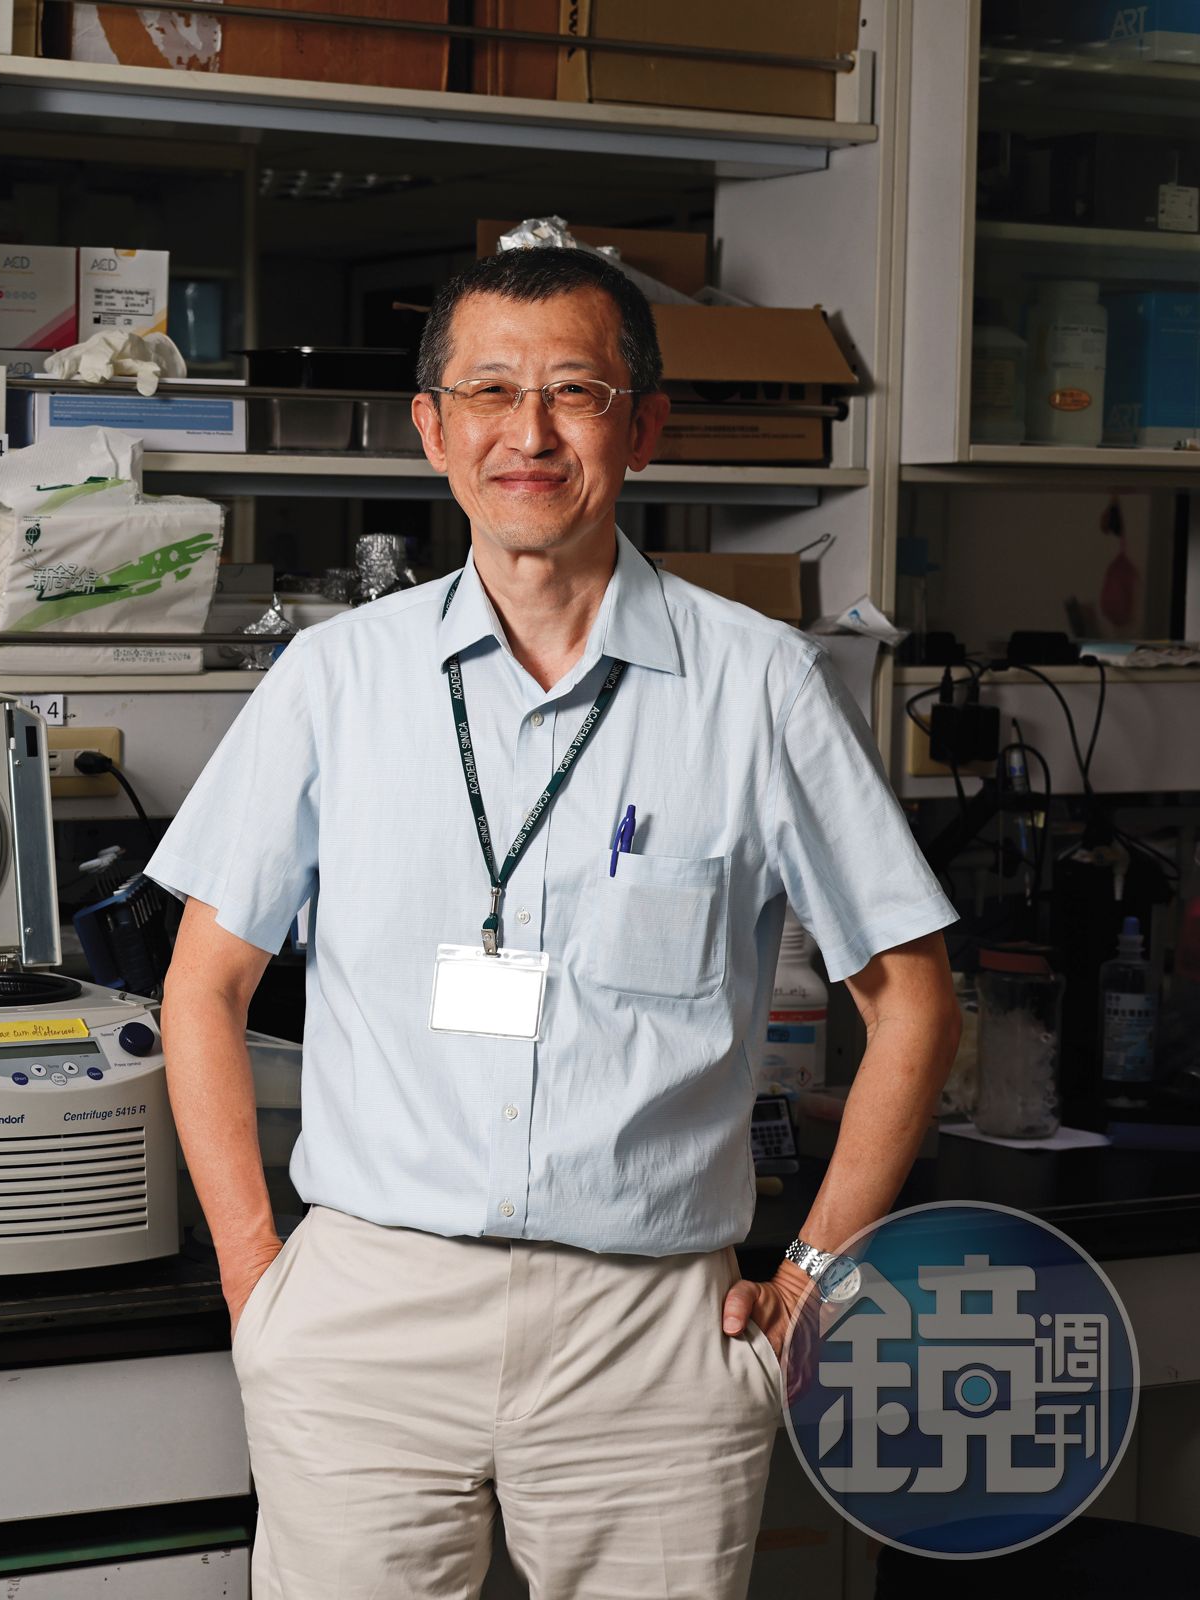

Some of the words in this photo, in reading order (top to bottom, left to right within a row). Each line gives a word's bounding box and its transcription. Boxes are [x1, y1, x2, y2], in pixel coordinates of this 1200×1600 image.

[3, 256, 30, 269] ACD
[90, 258, 117, 271] ACD
[7, 362, 32, 375] ACD
[604, 663, 623, 689] SINICA
[47, 701, 59, 719] 4
[459, 721, 473, 749] SINICA
[574, 706, 600, 746] ACADEMIA
[465, 749, 480, 795] ACADEMIA
[557, 747, 577, 774] SINICA
[524, 790, 551, 832] ACADEMIA
[477, 815, 490, 845] SINICA
[507, 831, 528, 858] SINICA
[63, 1109, 113, 1122] Centrifuge
[115, 1106, 137, 1117] 5415
[139, 1104, 146, 1114] R
